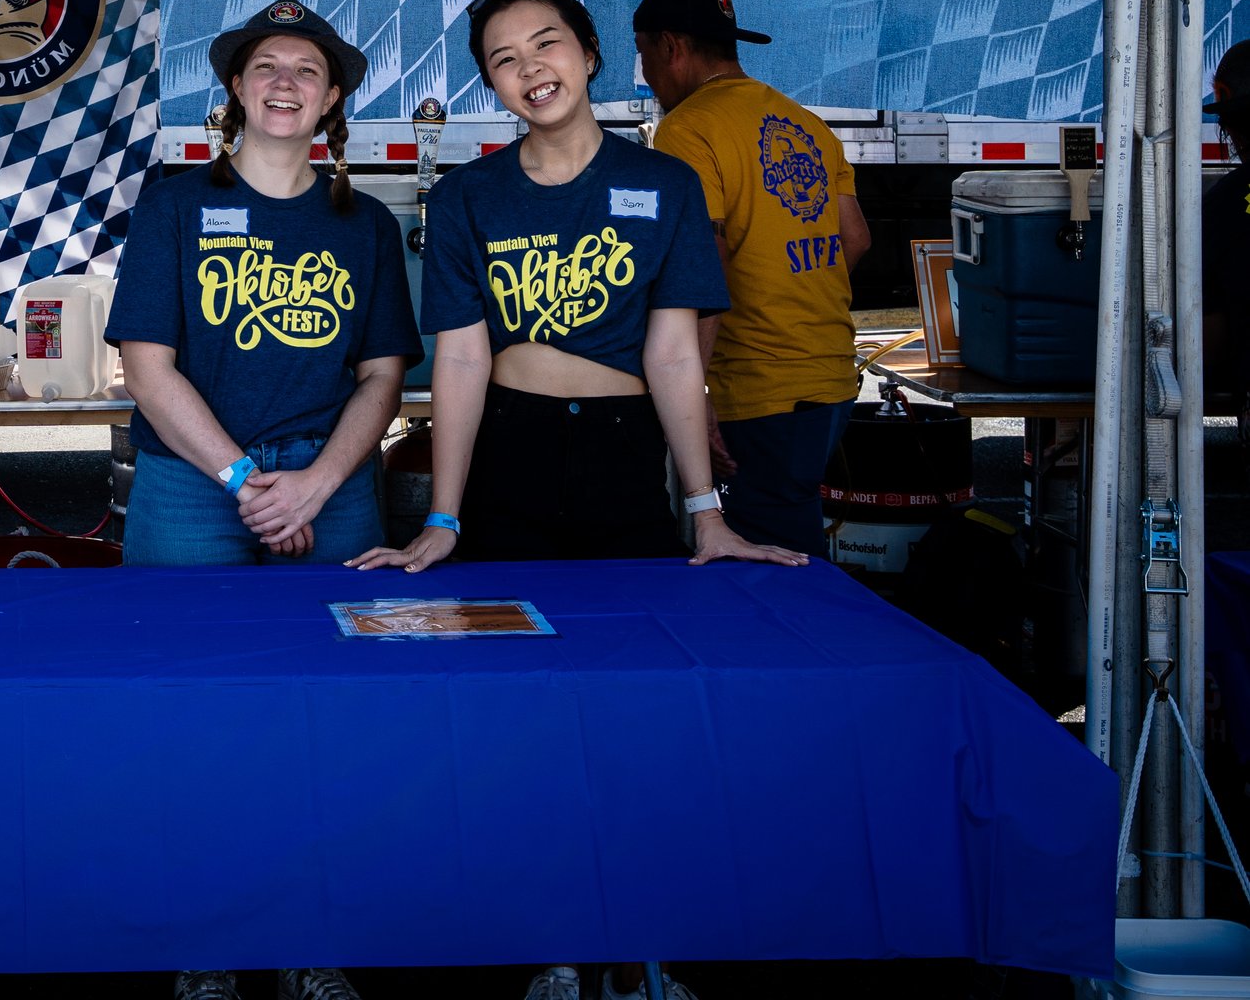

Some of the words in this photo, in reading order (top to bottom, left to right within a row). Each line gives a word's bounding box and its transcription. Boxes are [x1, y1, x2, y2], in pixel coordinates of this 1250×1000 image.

[1123, 54, 1130, 63] JM
[1122, 66, 1130, 87] EAGLE
[621, 199, 644, 208] Sam
[206, 218, 231, 226] Alana
[199, 236, 247, 251] Mountain
[249, 236, 273, 251] View
[486, 237, 529, 255] ountain
[531, 233, 558, 247] View
[198, 250, 355, 326] Oktober
[282, 308, 323, 333] FEST
[839, 540, 887, 555] Bischofshof
